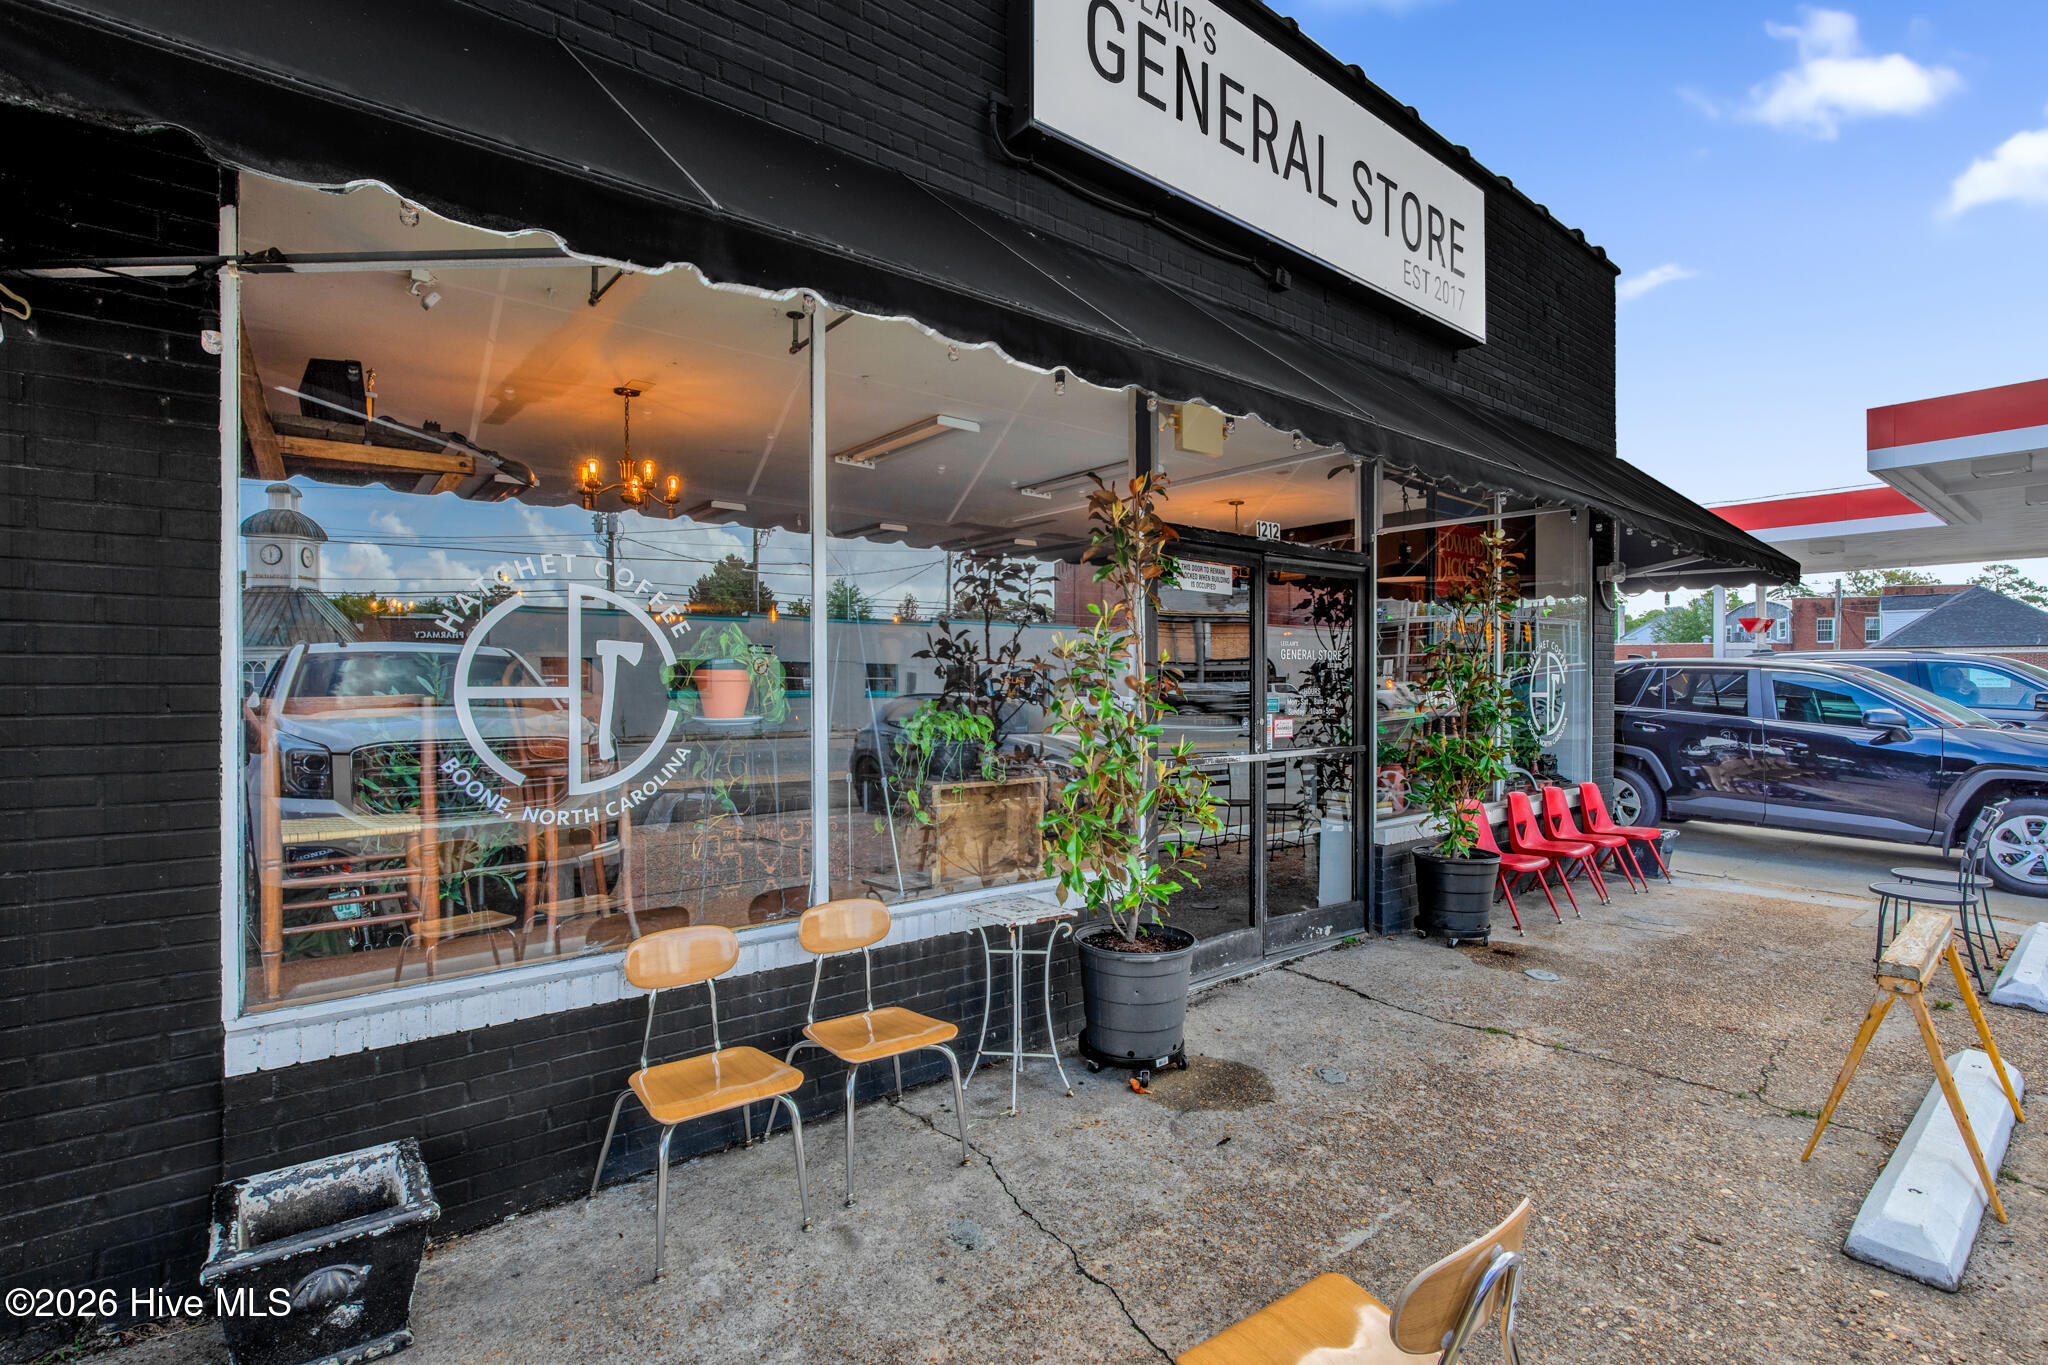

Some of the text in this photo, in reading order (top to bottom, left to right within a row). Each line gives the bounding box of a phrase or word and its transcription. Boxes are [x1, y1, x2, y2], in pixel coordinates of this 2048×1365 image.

[1128, 0, 1216, 55] AIR'S
[1086, 0, 1466, 278] GENERAL STORE
[1403, 260, 1465, 311] EST 2017
[1257, 521, 1279, 539] 1212
[1182, 563, 1191, 571] THIS
[1192, 564, 1203, 573] DOOR
[1210, 567, 1226, 575] REMAIN
[1196, 582, 1217, 591] OCCUPIED
[1199, 573, 1210, 582] WHEN
[1212, 575, 1230, 584] BUILDING
[434, 554, 692, 639] HATCHET COFFEE
[1280, 648, 1343, 660] GENERAL STORE
[1303, 687, 1321, 695] HOURS
[440, 747, 692, 826] BOONE, NORTH CAROLINA
